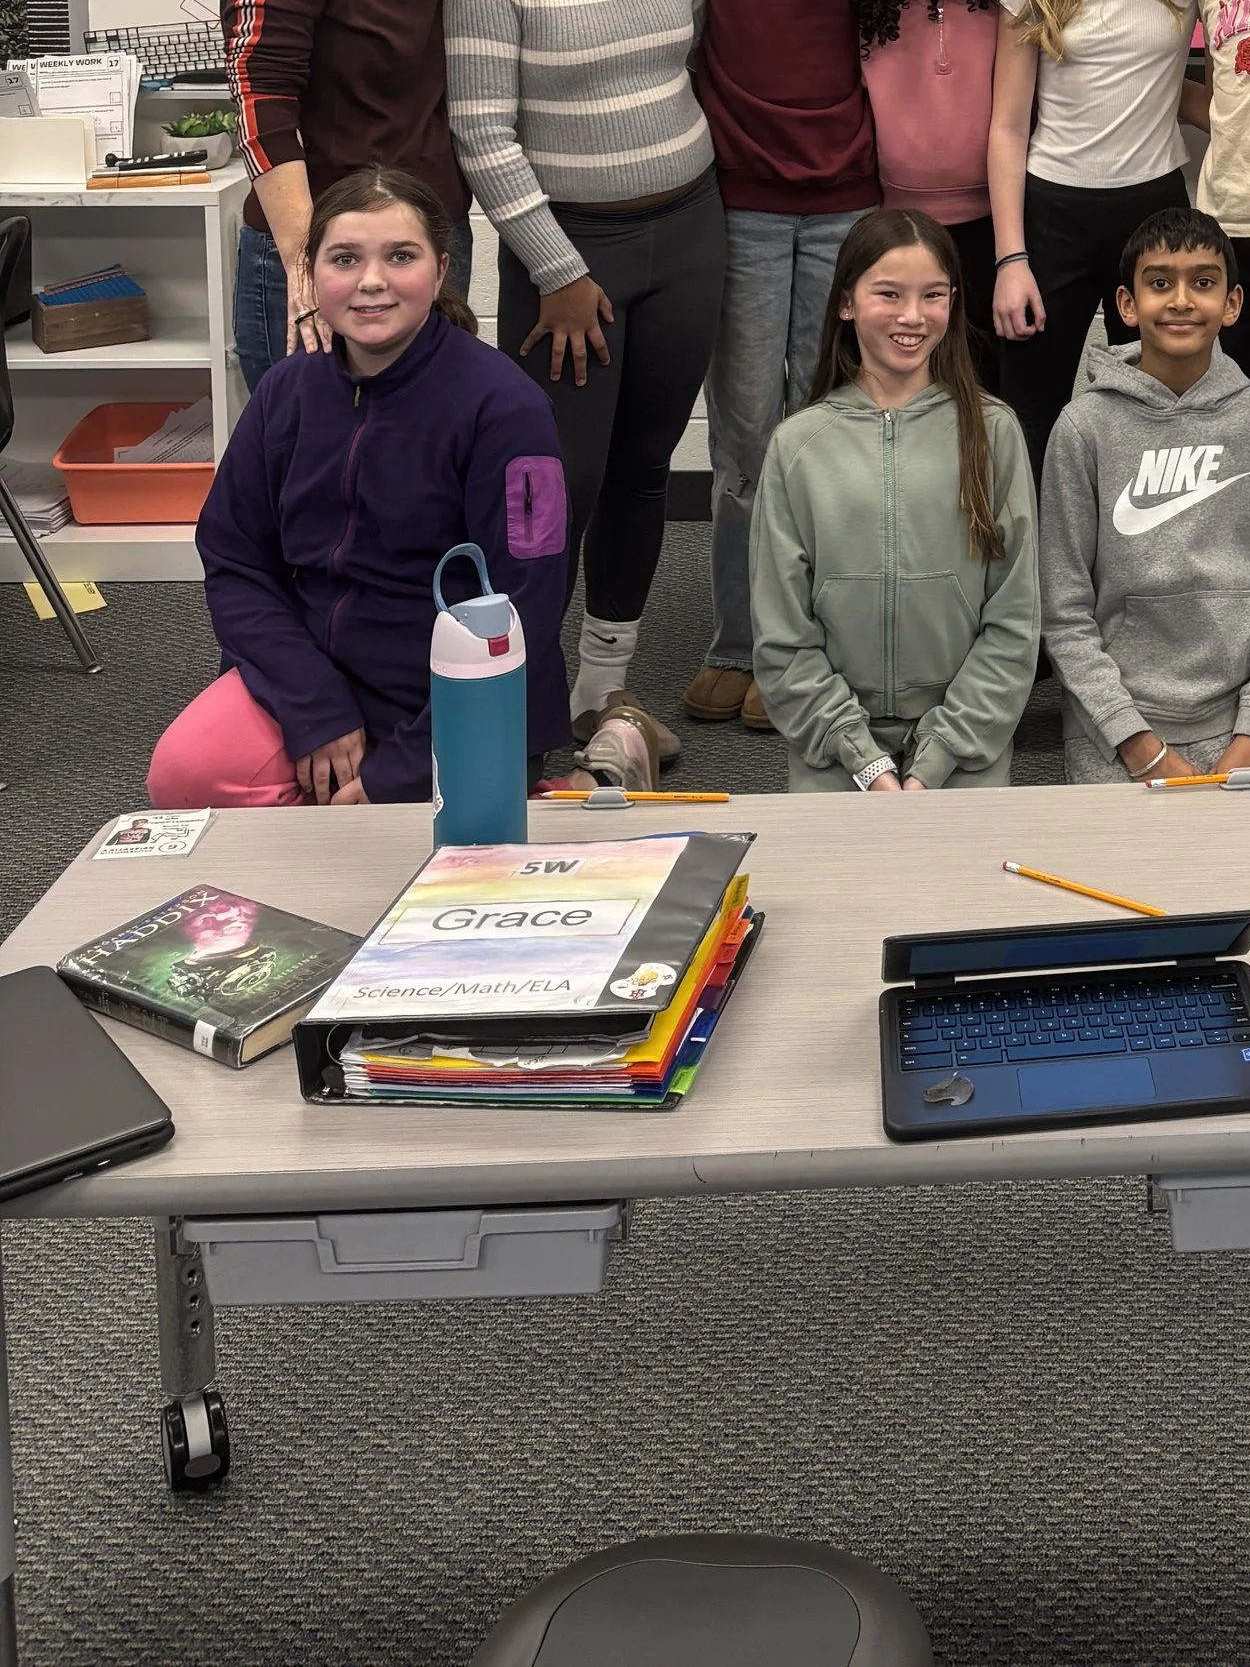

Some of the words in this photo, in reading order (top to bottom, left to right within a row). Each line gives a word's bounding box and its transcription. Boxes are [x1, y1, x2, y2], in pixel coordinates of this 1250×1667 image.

[40, 59, 75, 69] WEEKLY
[76, 58, 102, 67] WORK
[109, 59, 119, 67] 17
[1132, 444, 1226, 497] NIKE
[519, 859, 581, 876] 5W
[79, 890, 220, 967] HADDIX
[431, 908, 593, 931] Grace
[353, 979, 571, 1000] Science/Math/ELA
